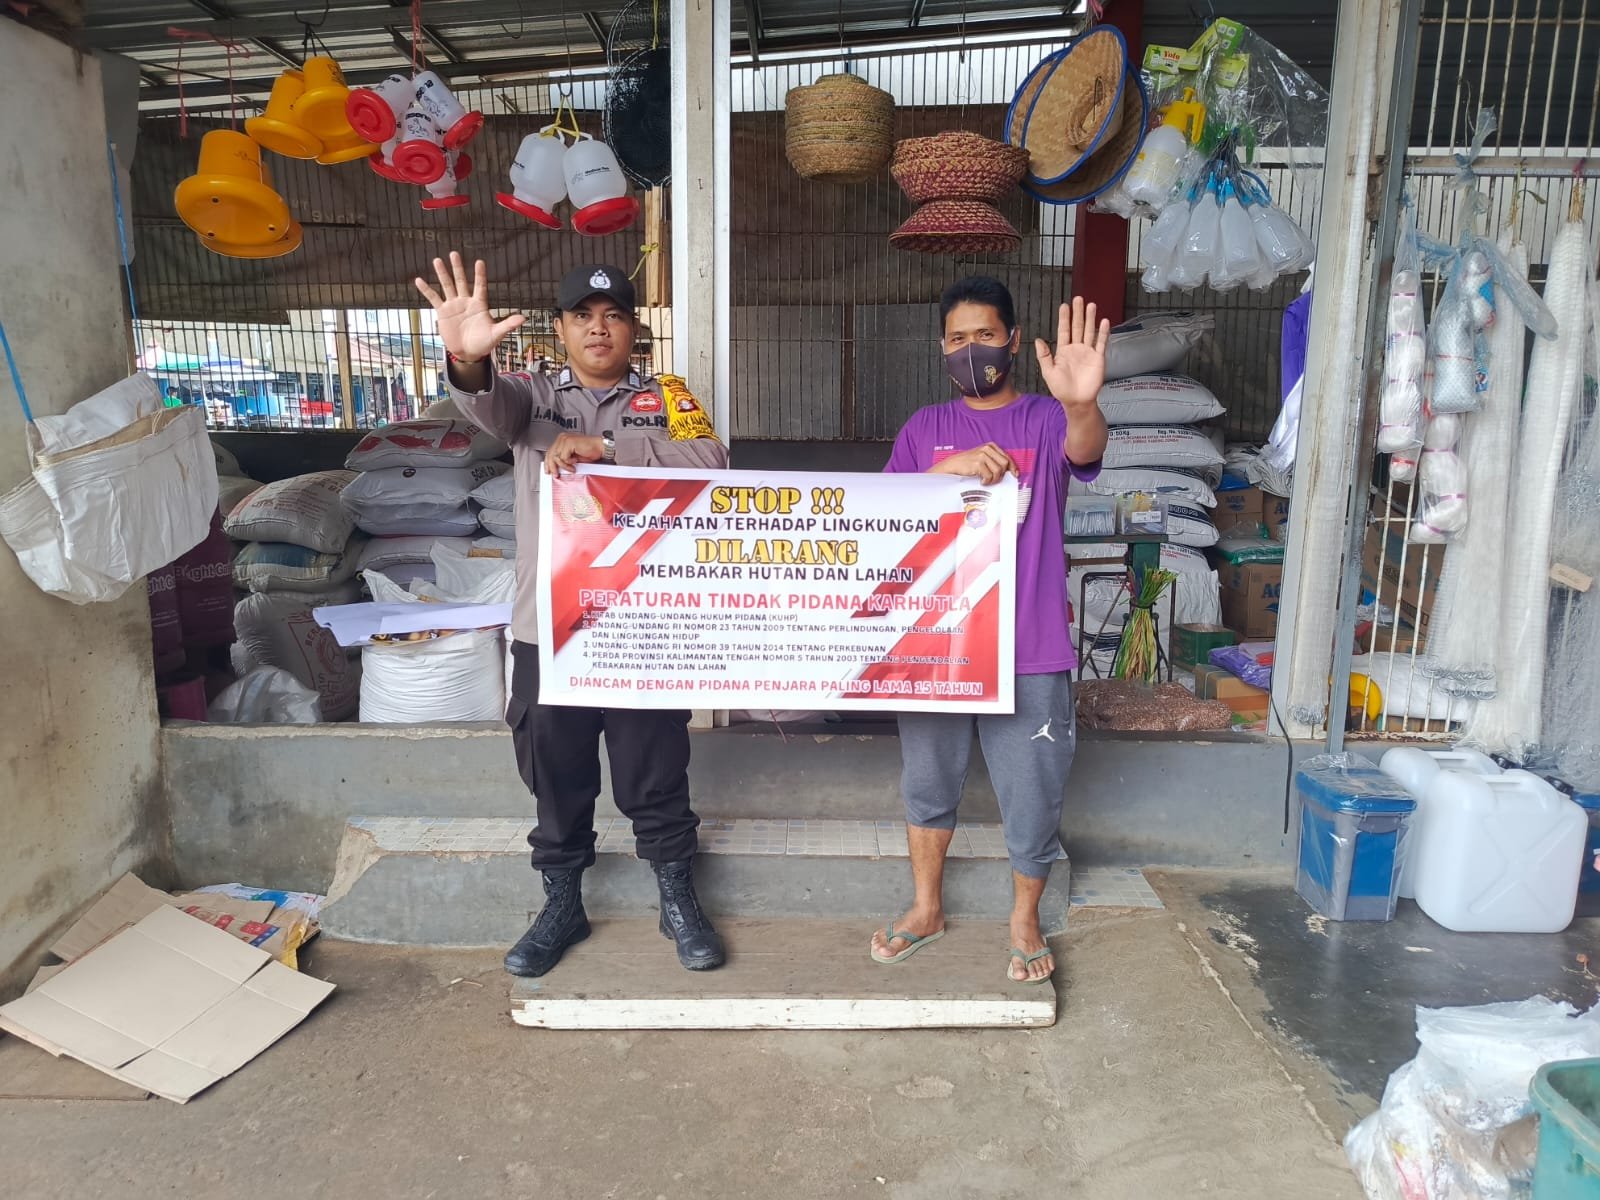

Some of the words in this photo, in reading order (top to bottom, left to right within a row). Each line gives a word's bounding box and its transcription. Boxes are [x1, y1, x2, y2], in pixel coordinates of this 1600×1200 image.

[621, 416, 668, 428] POLRI
[711, 486, 802, 514] STOP
[811, 487, 844, 515] !!!
[614, 514, 718, 530] KEJAHATAN
[724, 517, 816, 531] TERHADAP
[824, 518, 938, 532] LINGKUNGAN
[695, 538, 858, 566] DILARANG
[640, 564, 742, 579] MEMBAKAR
[749, 566, 806, 580] HUTAN
[814, 567, 848, 581] DAN
[856, 568, 912, 582] LAHAN
[580, 590, 700, 608] PERATURAN
[708, 592, 781, 608] TINDAK
[788, 594, 862, 610] PIDANA
[868, 594, 970, 611] KARHUTLA
[592, 622, 670, 630] UNDANG-UNDANG
[769, 614, 798, 622] (KUHP)
[592, 642, 670, 650] UNDANG-UNDANG
[592, 662, 642, 670] KEBAKARAN
[570, 676, 632, 689] DIANCAM
[636, 680, 694, 690] DENGAN
[700, 680, 750, 690] PIDANA
[754, 680, 816, 691] PENJARA
[822, 681, 870, 692] PALING
[874, 682, 912, 694] LAMA
[916, 682, 931, 693] 15
[936, 684, 982, 694] TAHUN
